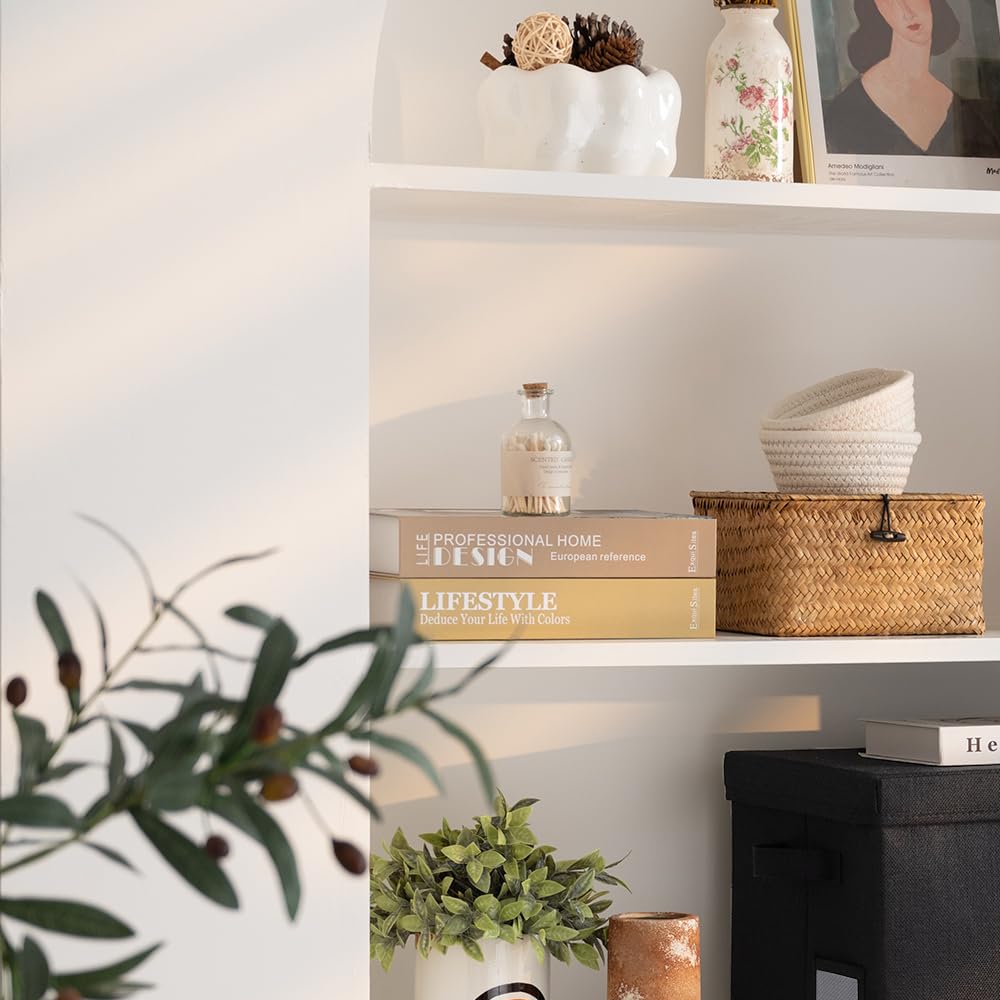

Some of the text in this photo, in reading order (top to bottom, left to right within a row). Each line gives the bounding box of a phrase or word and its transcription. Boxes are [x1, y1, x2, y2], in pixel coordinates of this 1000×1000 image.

[433, 533, 601, 547] PROFESSIONAL HOME
[416, 533, 428, 566] LIFE
[433, 546, 534, 567] DESIGN
[550, 551, 647, 563] European reference
[419, 591, 558, 612] LIFESTYLE
[420, 612, 571, 625] Deduce Your Life With Colors
